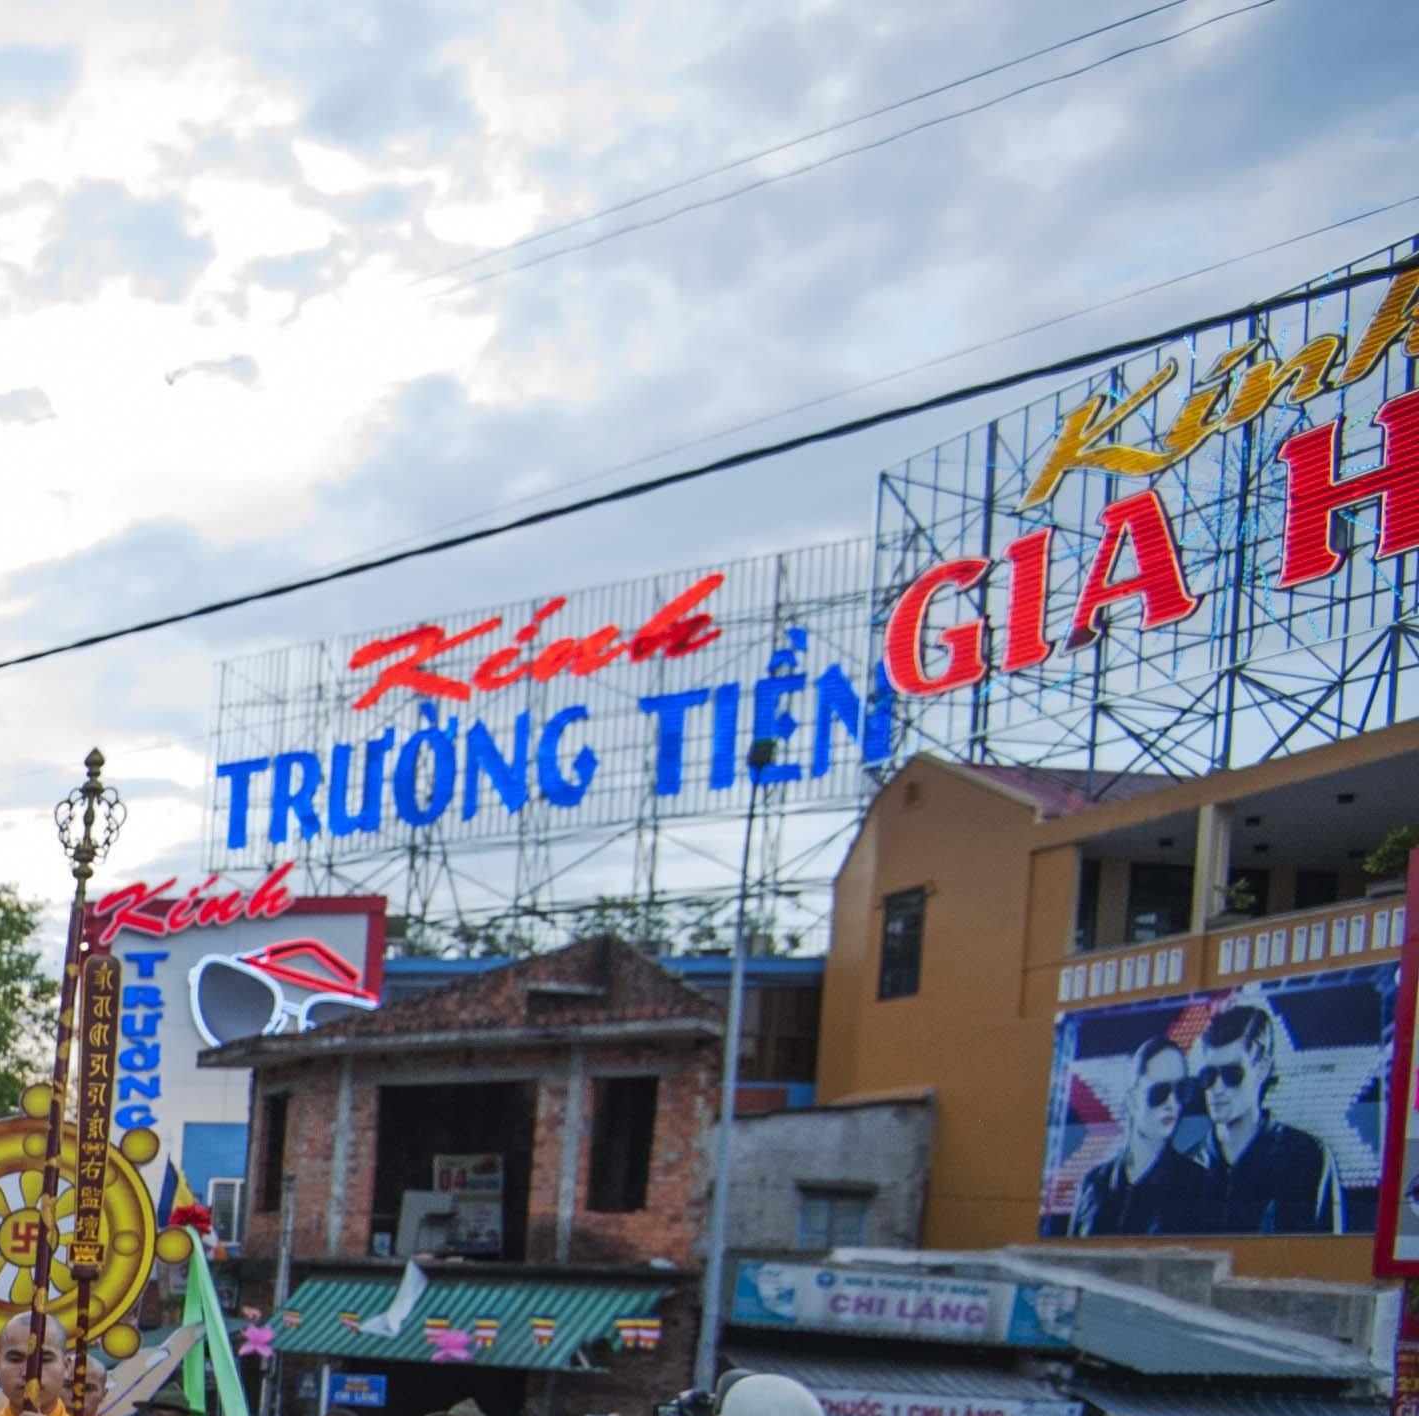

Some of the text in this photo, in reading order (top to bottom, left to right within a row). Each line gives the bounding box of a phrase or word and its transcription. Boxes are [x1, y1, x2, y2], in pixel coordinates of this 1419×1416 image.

[347, 573, 725, 711] Kính
[883, 489, 1204, 698] GIA
[216, 627, 896, 850] TRƯỜNG TIỀN
[93, 861, 296, 945] Kính
[114, 951, 170, 1130] TRƯỜNG
[828, 1293, 887, 1316] CHI
